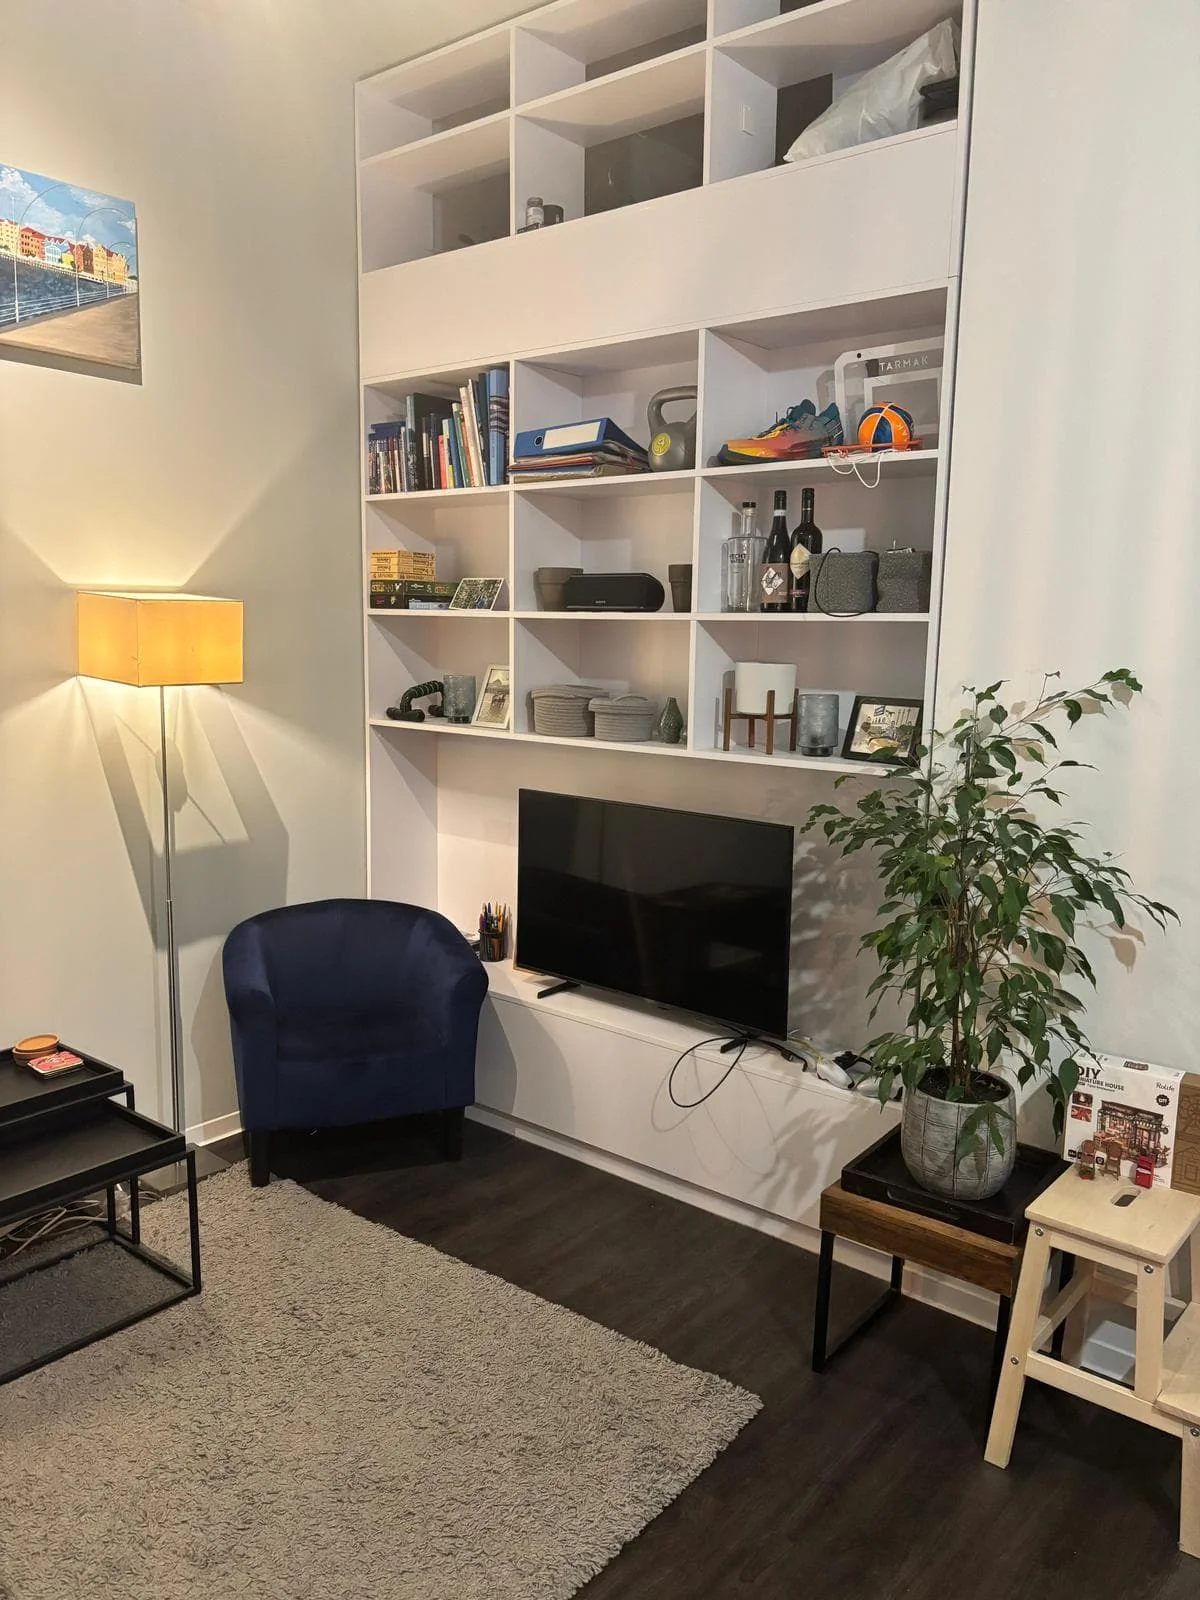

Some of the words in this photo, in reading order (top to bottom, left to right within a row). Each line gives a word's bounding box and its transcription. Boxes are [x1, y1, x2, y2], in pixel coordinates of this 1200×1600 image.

[879, 355, 929, 373] TARMAK
[1078, 1065, 1101, 1080] DIY
[1104, 1082, 1124, 1091] HOUSE
